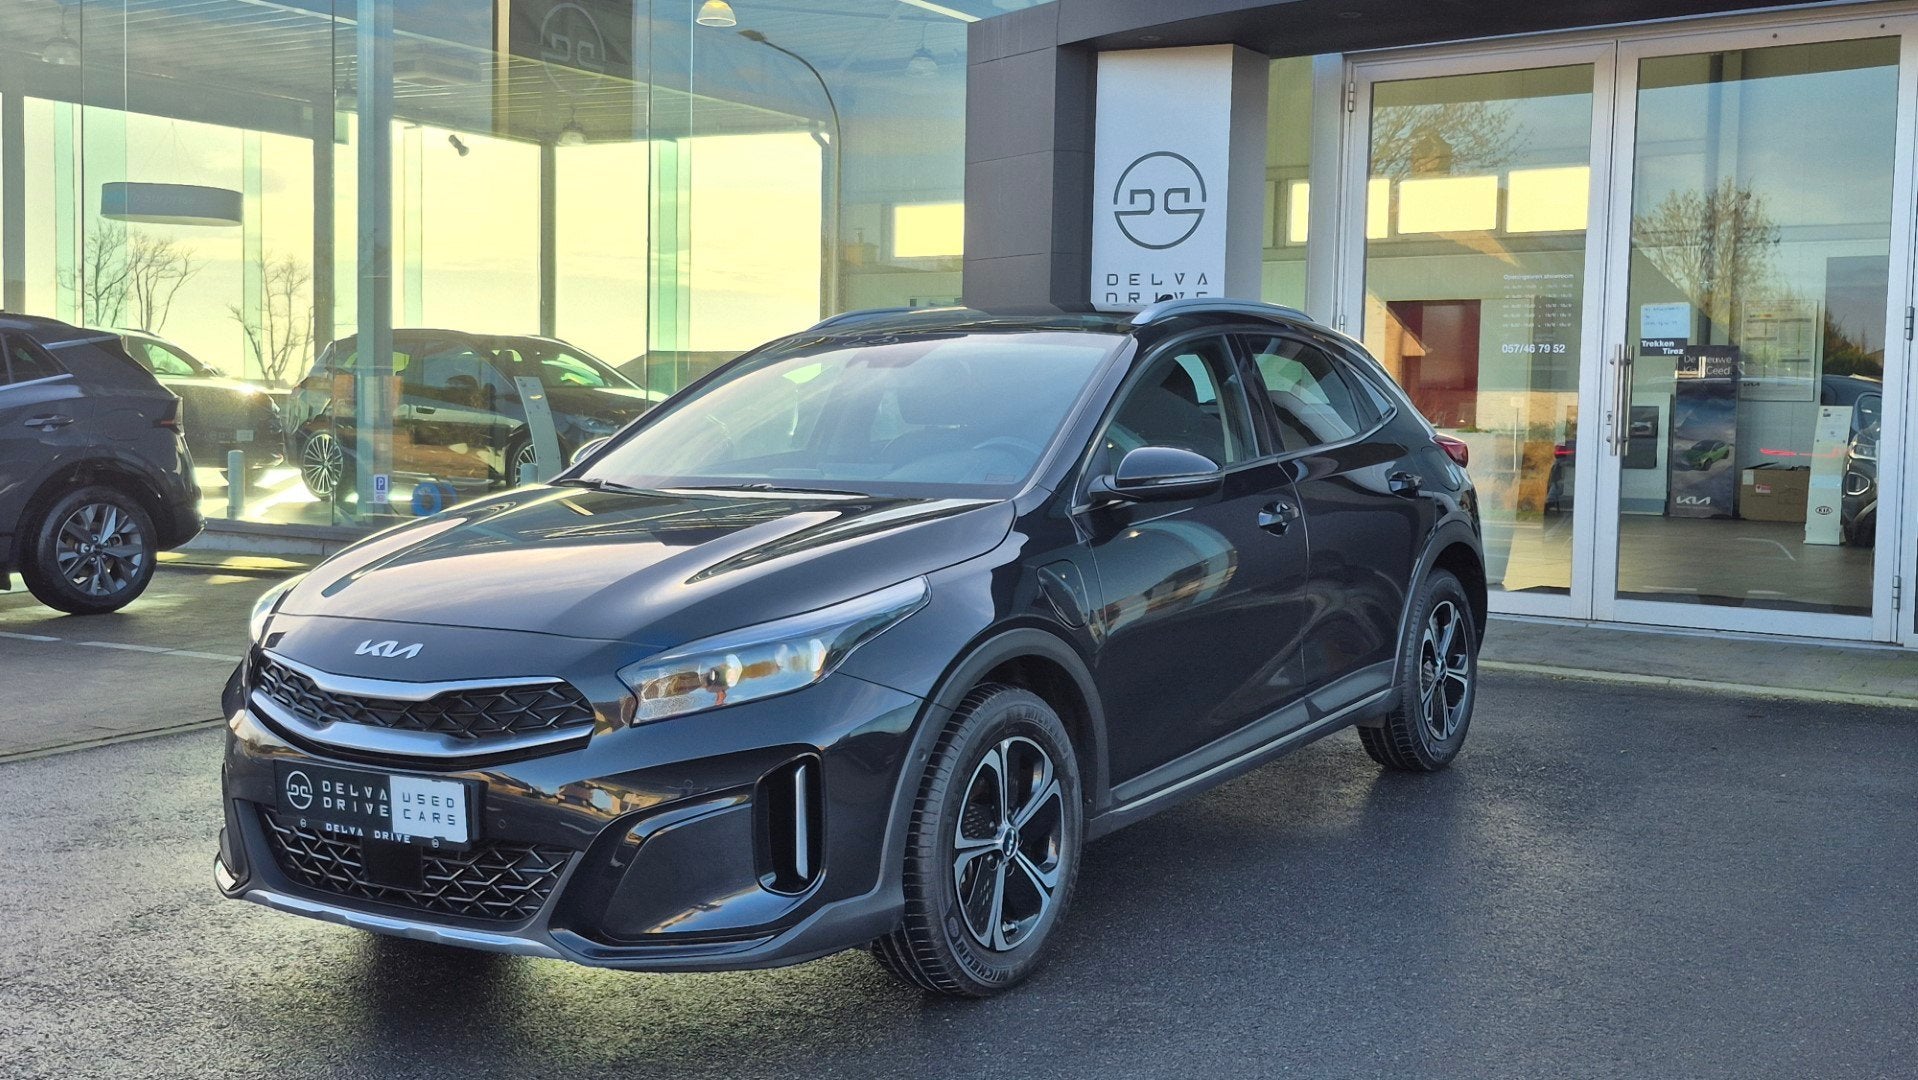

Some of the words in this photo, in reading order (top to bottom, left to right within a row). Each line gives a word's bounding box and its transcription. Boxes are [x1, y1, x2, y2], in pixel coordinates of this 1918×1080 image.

[1106, 272, 1208, 286] DELVA
[1502, 344, 1535, 353] 057/46
[1538, 344, 1550, 352] 79
[1553, 344, 1565, 353] 52
[1684, 355, 1696, 363] De
[355, 639, 424, 659] KIA
[322, 780, 389, 801] DELVA
[402, 792, 454, 808] USED
[322, 797, 390, 817] DRIVE
[403, 808, 456, 826] CARS
[326, 822, 364, 837] DELVA
[374, 830, 411, 844] DRIVE
